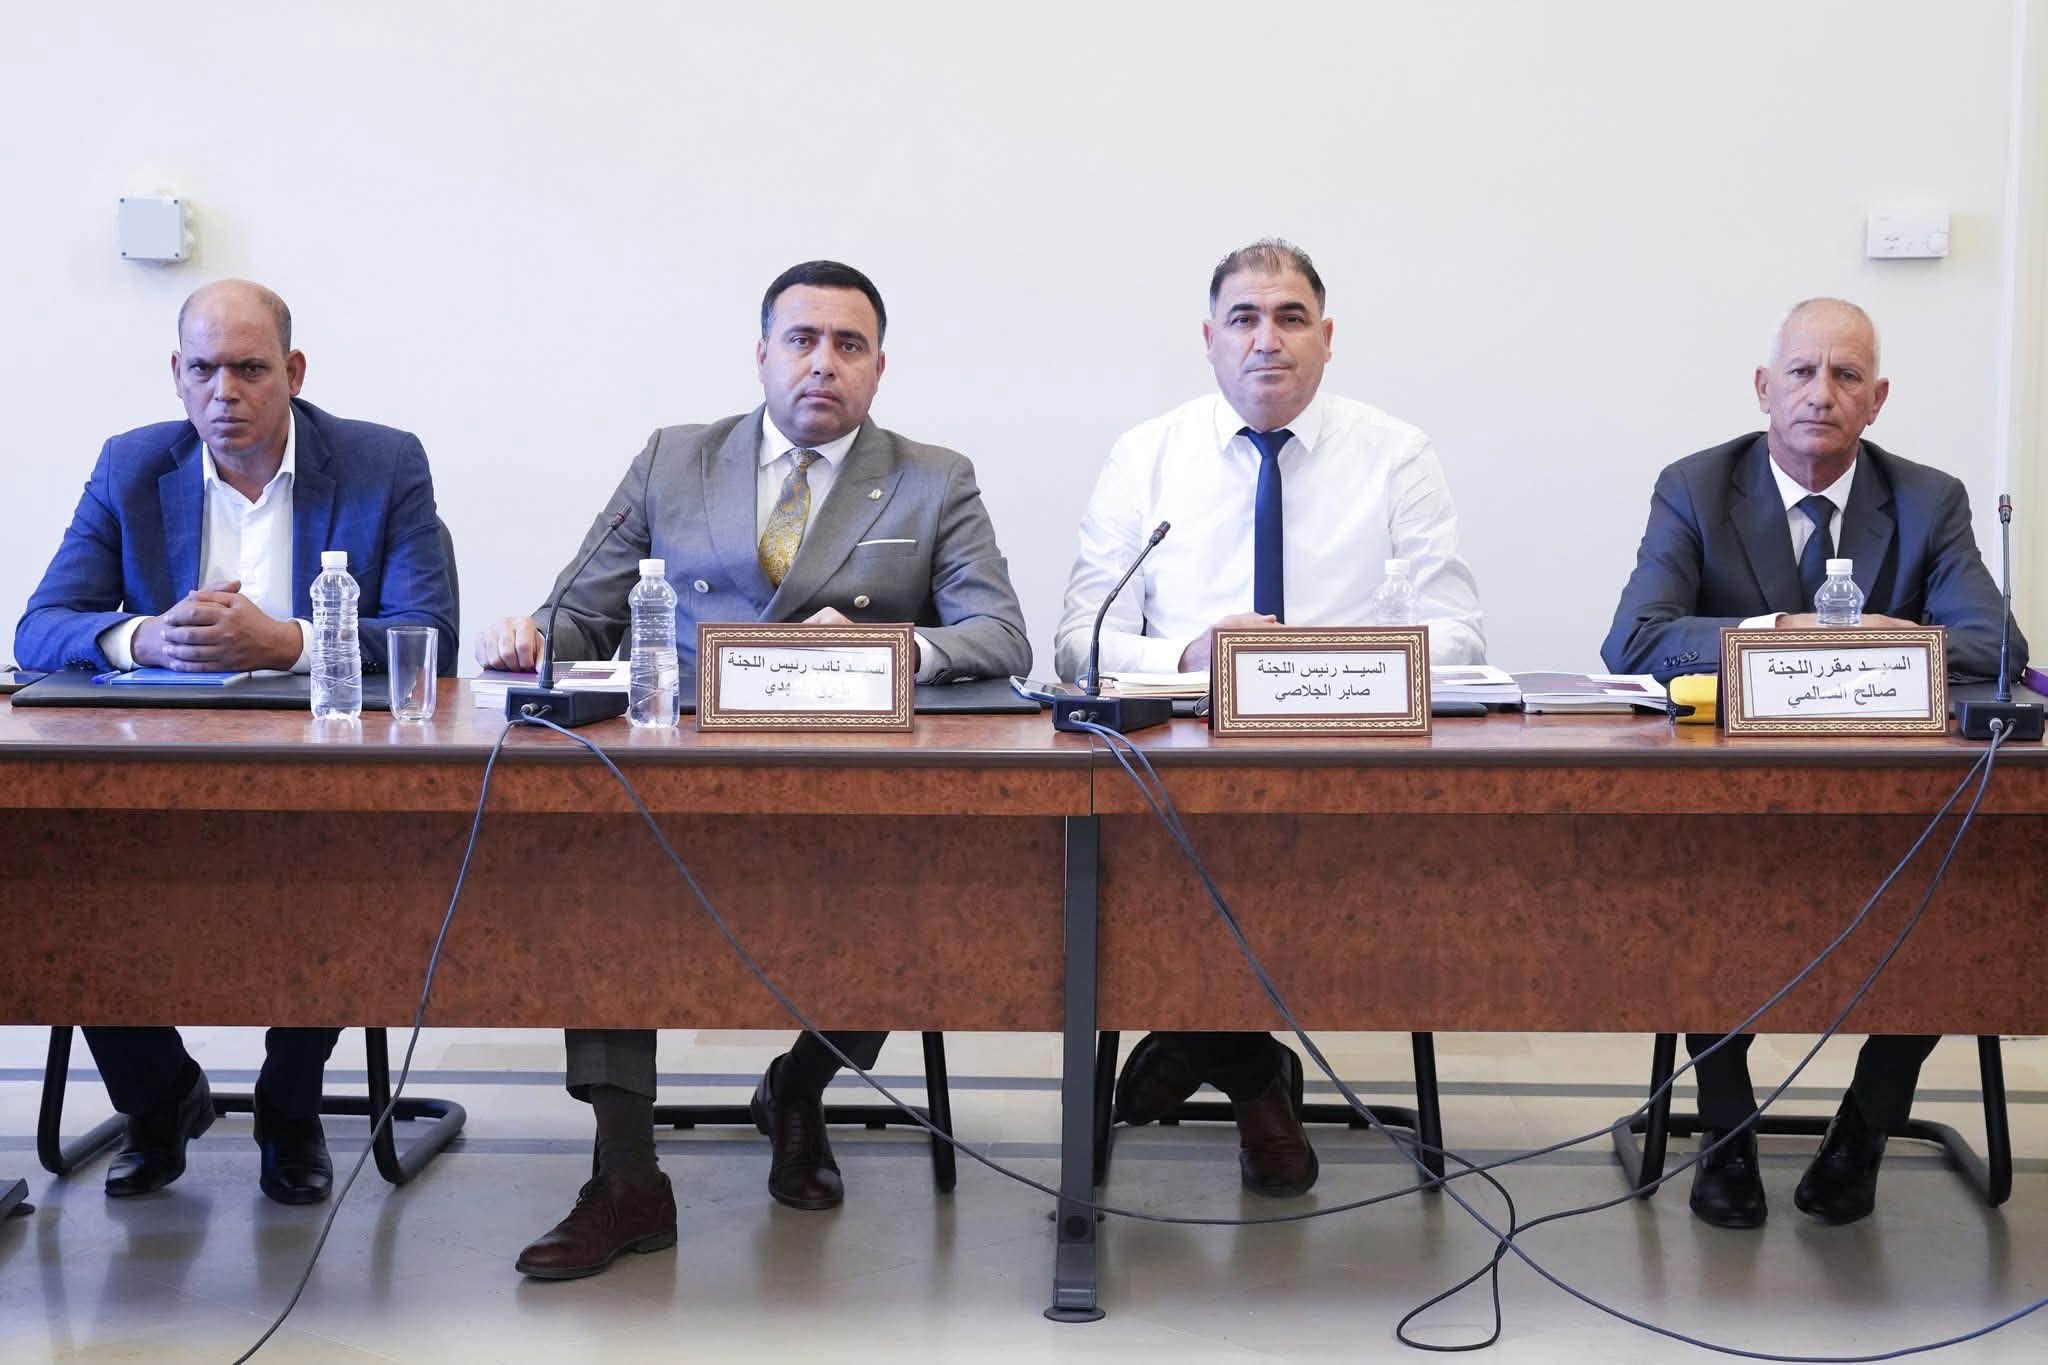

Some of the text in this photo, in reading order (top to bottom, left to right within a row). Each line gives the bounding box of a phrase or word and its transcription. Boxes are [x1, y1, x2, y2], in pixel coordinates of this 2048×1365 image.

[727, 651, 765, 673] اللجنة
[769, 656, 808, 675] رئيس
[1257, 658, 1387, 679] السيد رئيس اللجنة
[1857, 656, 1911, 675] السيد
[1275, 683, 1371, 703] صابر الجلاصي
[1854, 683, 1897, 705] صالح
